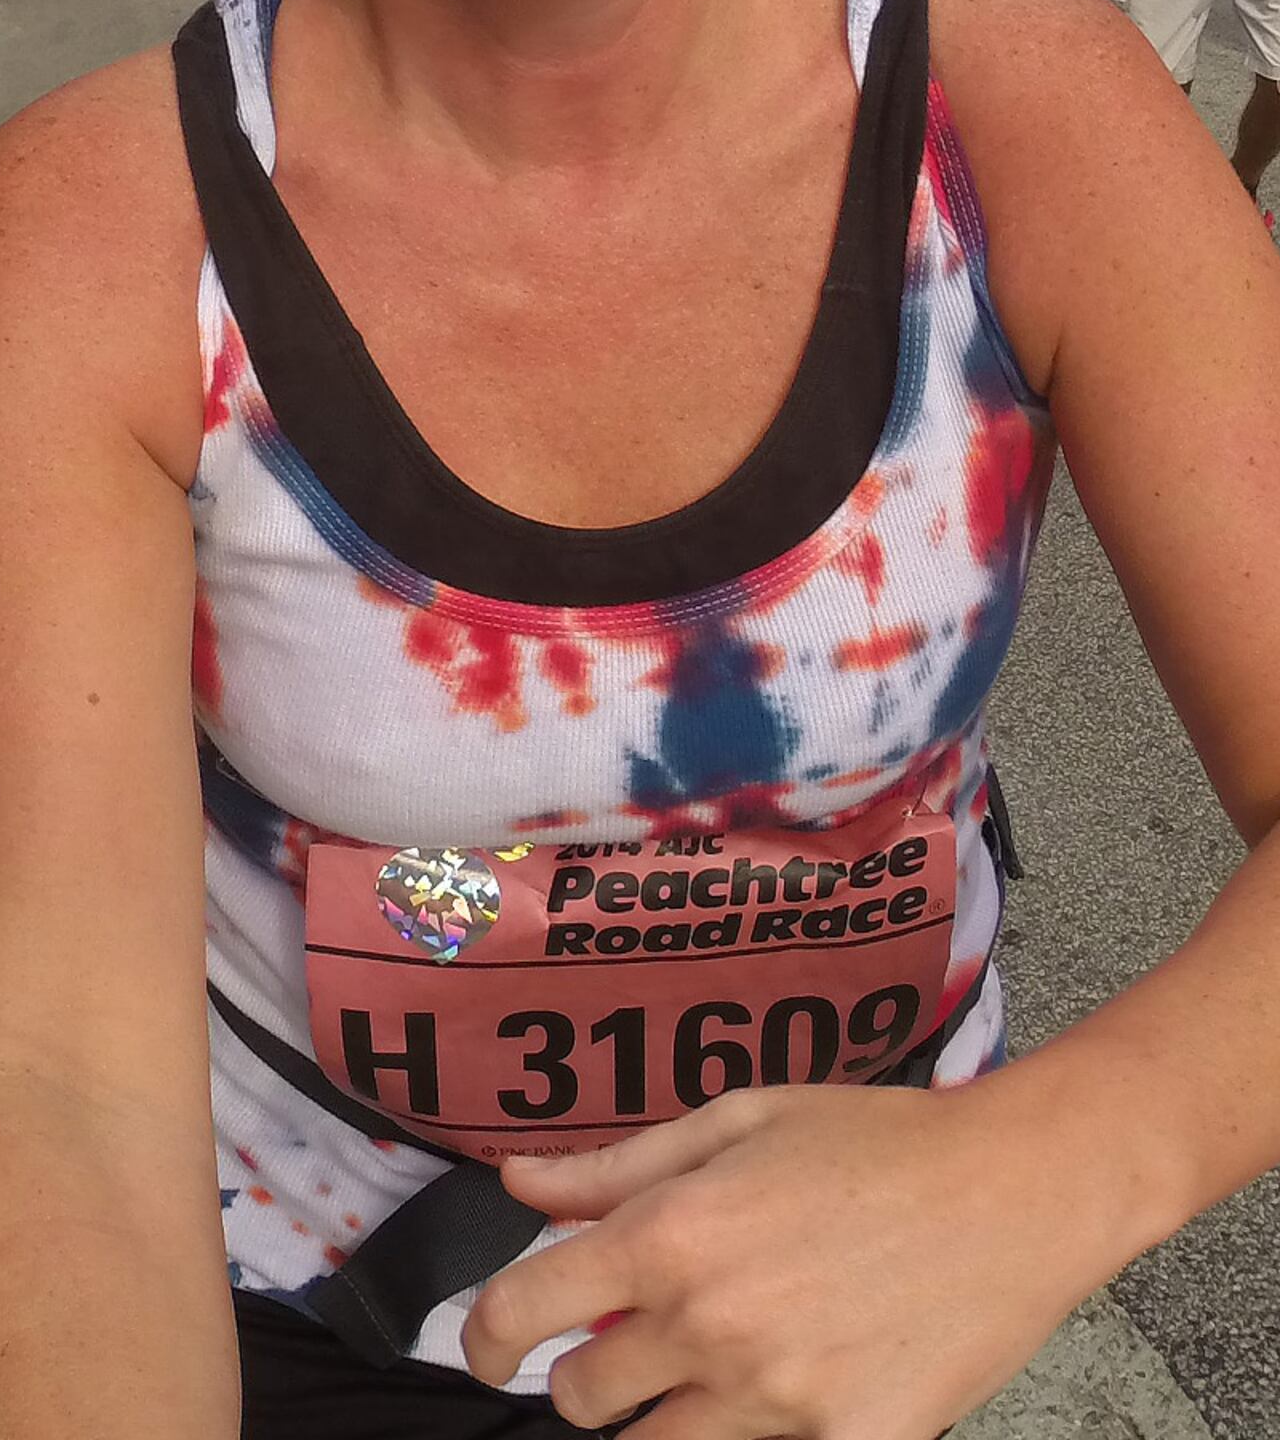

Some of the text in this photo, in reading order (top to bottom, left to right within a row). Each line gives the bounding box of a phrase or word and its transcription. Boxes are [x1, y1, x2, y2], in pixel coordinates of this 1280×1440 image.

[547, 836, 929, 913] Peachtree
[655, 833, 725, 857] AJC
[545, 885, 928, 956] Road Race
[340, 983, 922, 1121] H 31609
